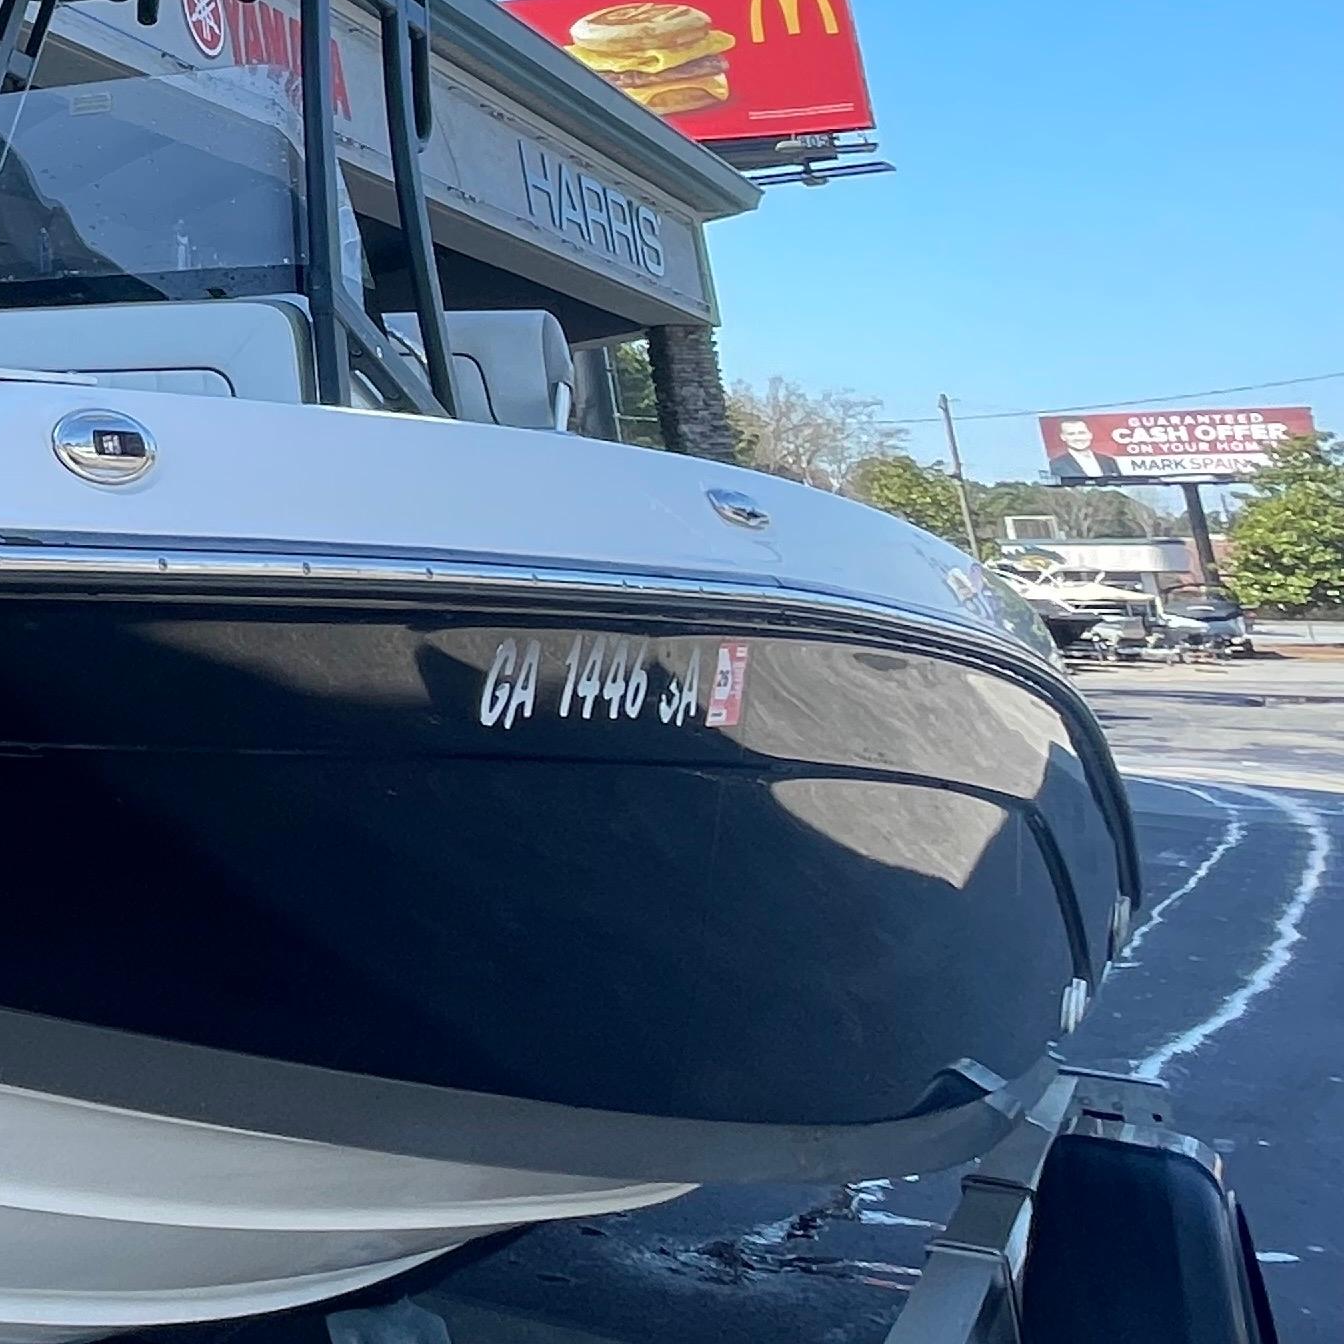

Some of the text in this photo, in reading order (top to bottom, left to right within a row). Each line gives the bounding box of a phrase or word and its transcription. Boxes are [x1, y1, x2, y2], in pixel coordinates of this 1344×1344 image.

[518, 139, 665, 277] HARRIS
[1127, 413, 1264, 427] GUARANTEED
[1112, 423, 1289, 443] CASH OFFER
[1126, 443, 1154, 454] ON
[1159, 442, 1211, 453] YOUR
[1131, 458, 1186, 471] MARK
[480, 638, 542, 730] GA
[559, 634, 649, 720] 1446
